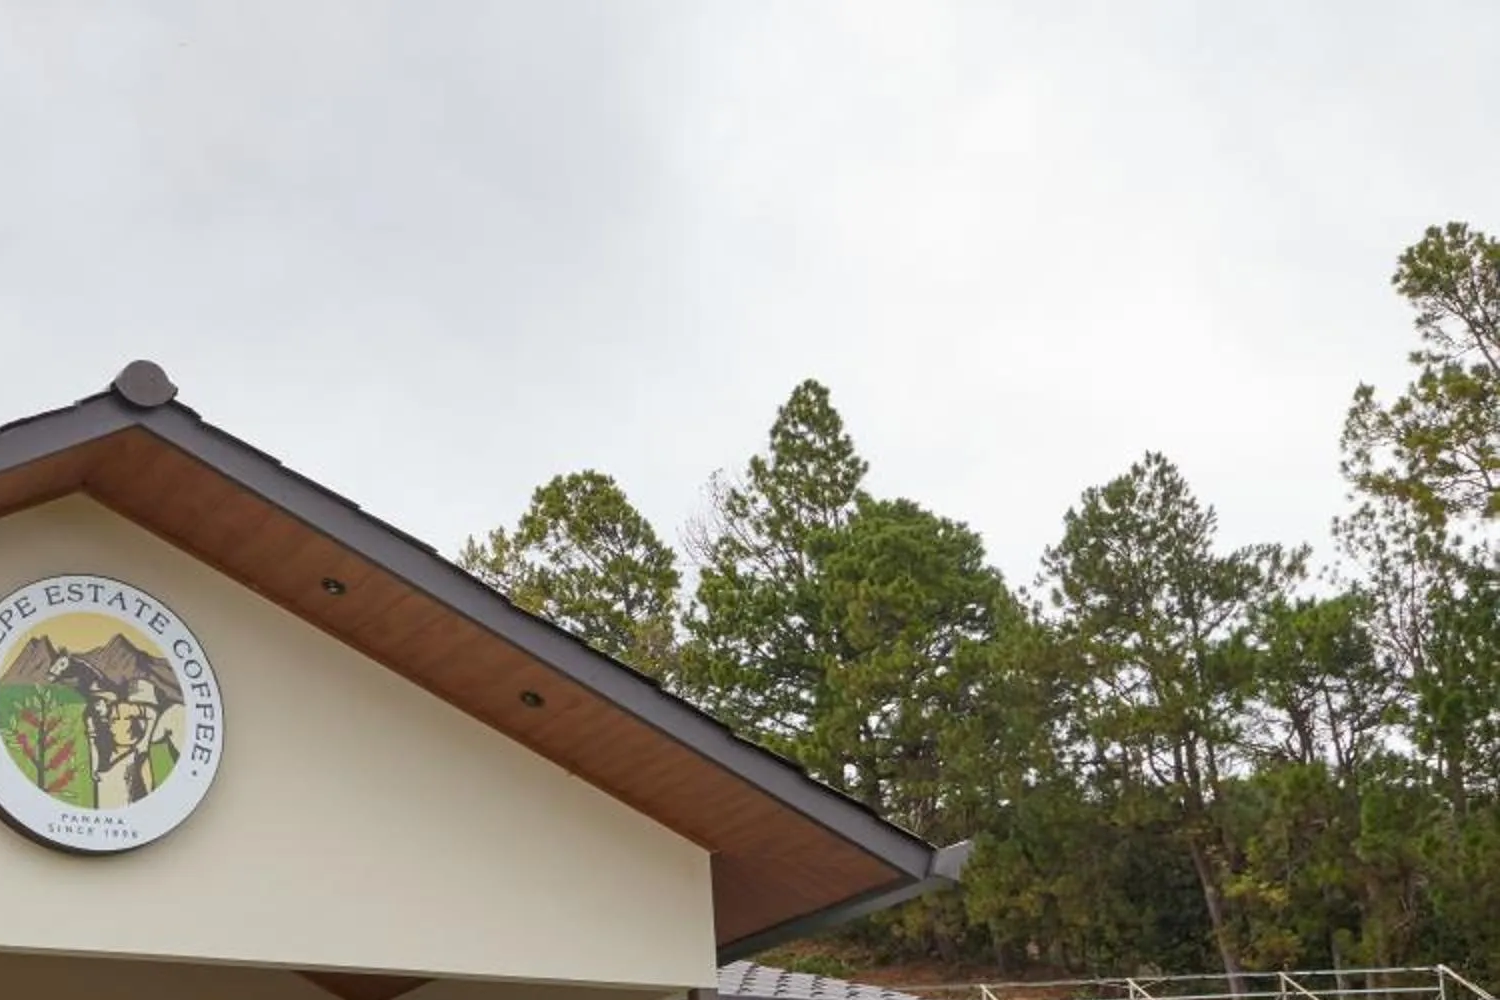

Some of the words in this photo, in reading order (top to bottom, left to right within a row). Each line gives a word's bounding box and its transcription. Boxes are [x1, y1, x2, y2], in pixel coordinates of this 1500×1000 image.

[44, 583, 171, 635] ESTATE
[172, 638, 216, 766] COFFEE
[46, 823, 96, 836] SINCE
